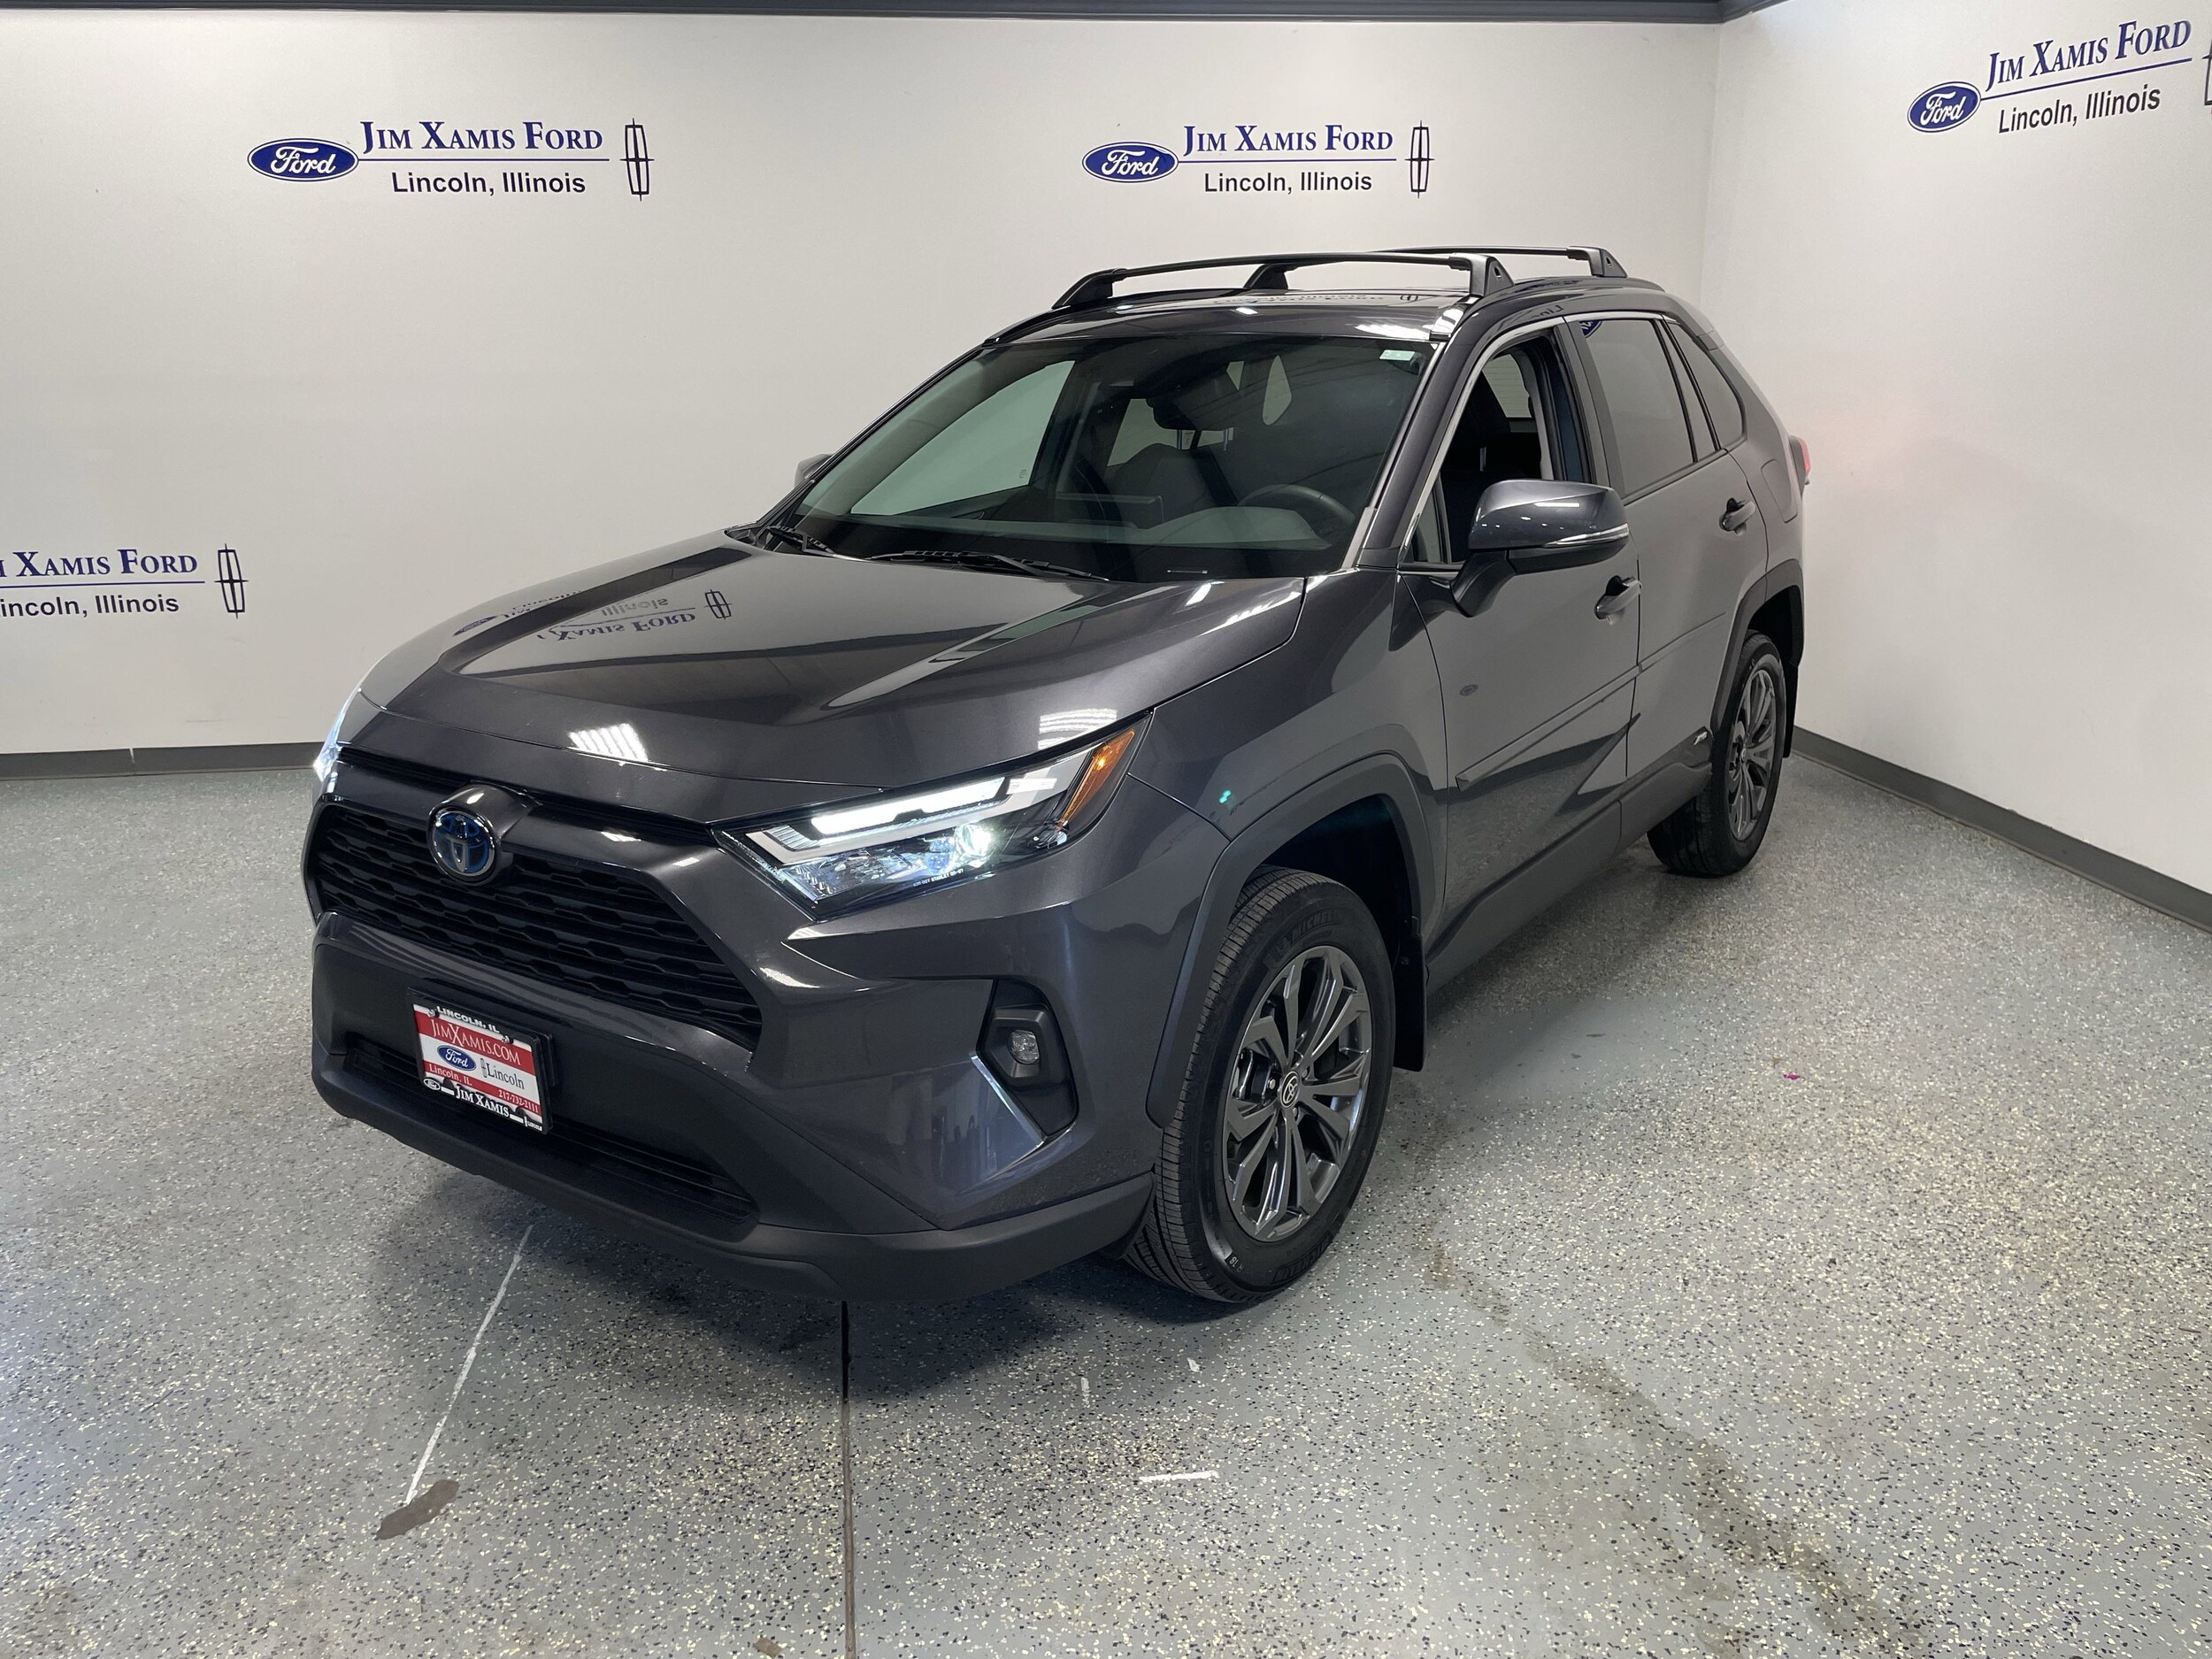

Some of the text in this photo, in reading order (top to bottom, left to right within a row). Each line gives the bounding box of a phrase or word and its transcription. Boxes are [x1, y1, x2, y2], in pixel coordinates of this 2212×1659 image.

[1985, 19, 2192, 92] JIM XAMIS FORD
[1919, 91, 1968, 127] Ford
[1998, 84, 2161, 134] Lincoln, Illinois
[359, 121, 603, 155] JIM XAMIS FORD
[1183, 124, 1394, 157] JIM XAMIS FORD
[269, 145, 337, 176] Ford
[1101, 149, 1160, 176] Ford
[391, 172, 587, 196] Lincoln, Illinois
[1204, 172, 1372, 195] Lincoln, Illinois
[12, 551, 111, 578] XAMIS
[117, 549, 198, 574] FORD
[0, 594, 180, 618] incoln, Illinois
[436, 1005, 500, 1033] LINCOLN, IL
[431, 1019, 521, 1066] JIMXAMIS.COM
[445, 1048, 469, 1068] Ford
[428, 1064, 472, 1086] Lincoln, IL
[487, 1063, 526, 1090] Lincoln
[456, 1085, 510, 1118] JIM XAMIS
[497, 1089, 540, 1113] 217-732-2111
[1229, 1256, 1240, 1268] 18
